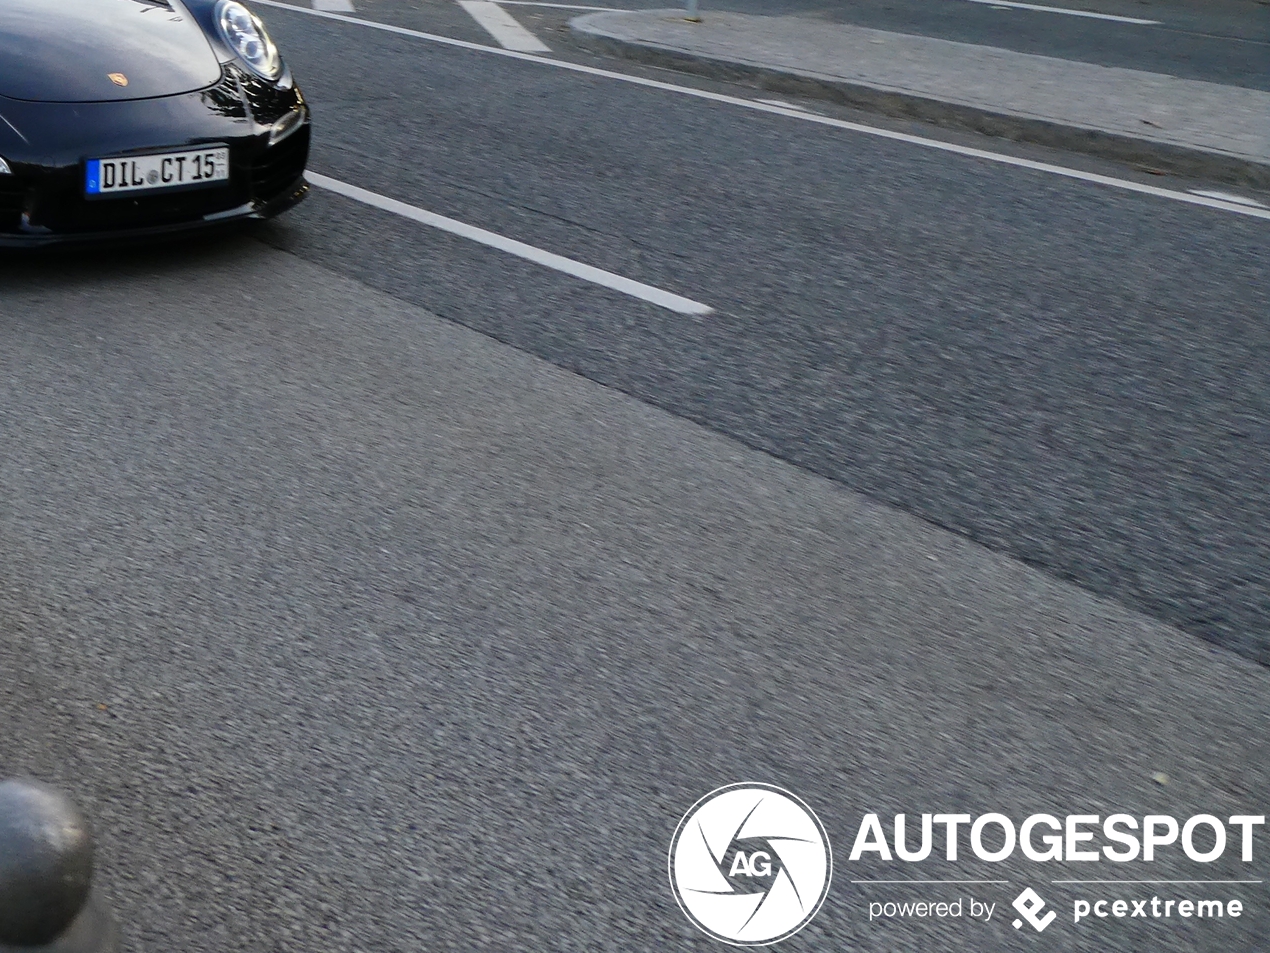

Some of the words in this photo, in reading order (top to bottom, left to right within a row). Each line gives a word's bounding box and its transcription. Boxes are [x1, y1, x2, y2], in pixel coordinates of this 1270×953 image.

[103, 162, 143, 188] DIL
[161, 157, 186, 183] CT
[192, 153, 215, 180] 15
